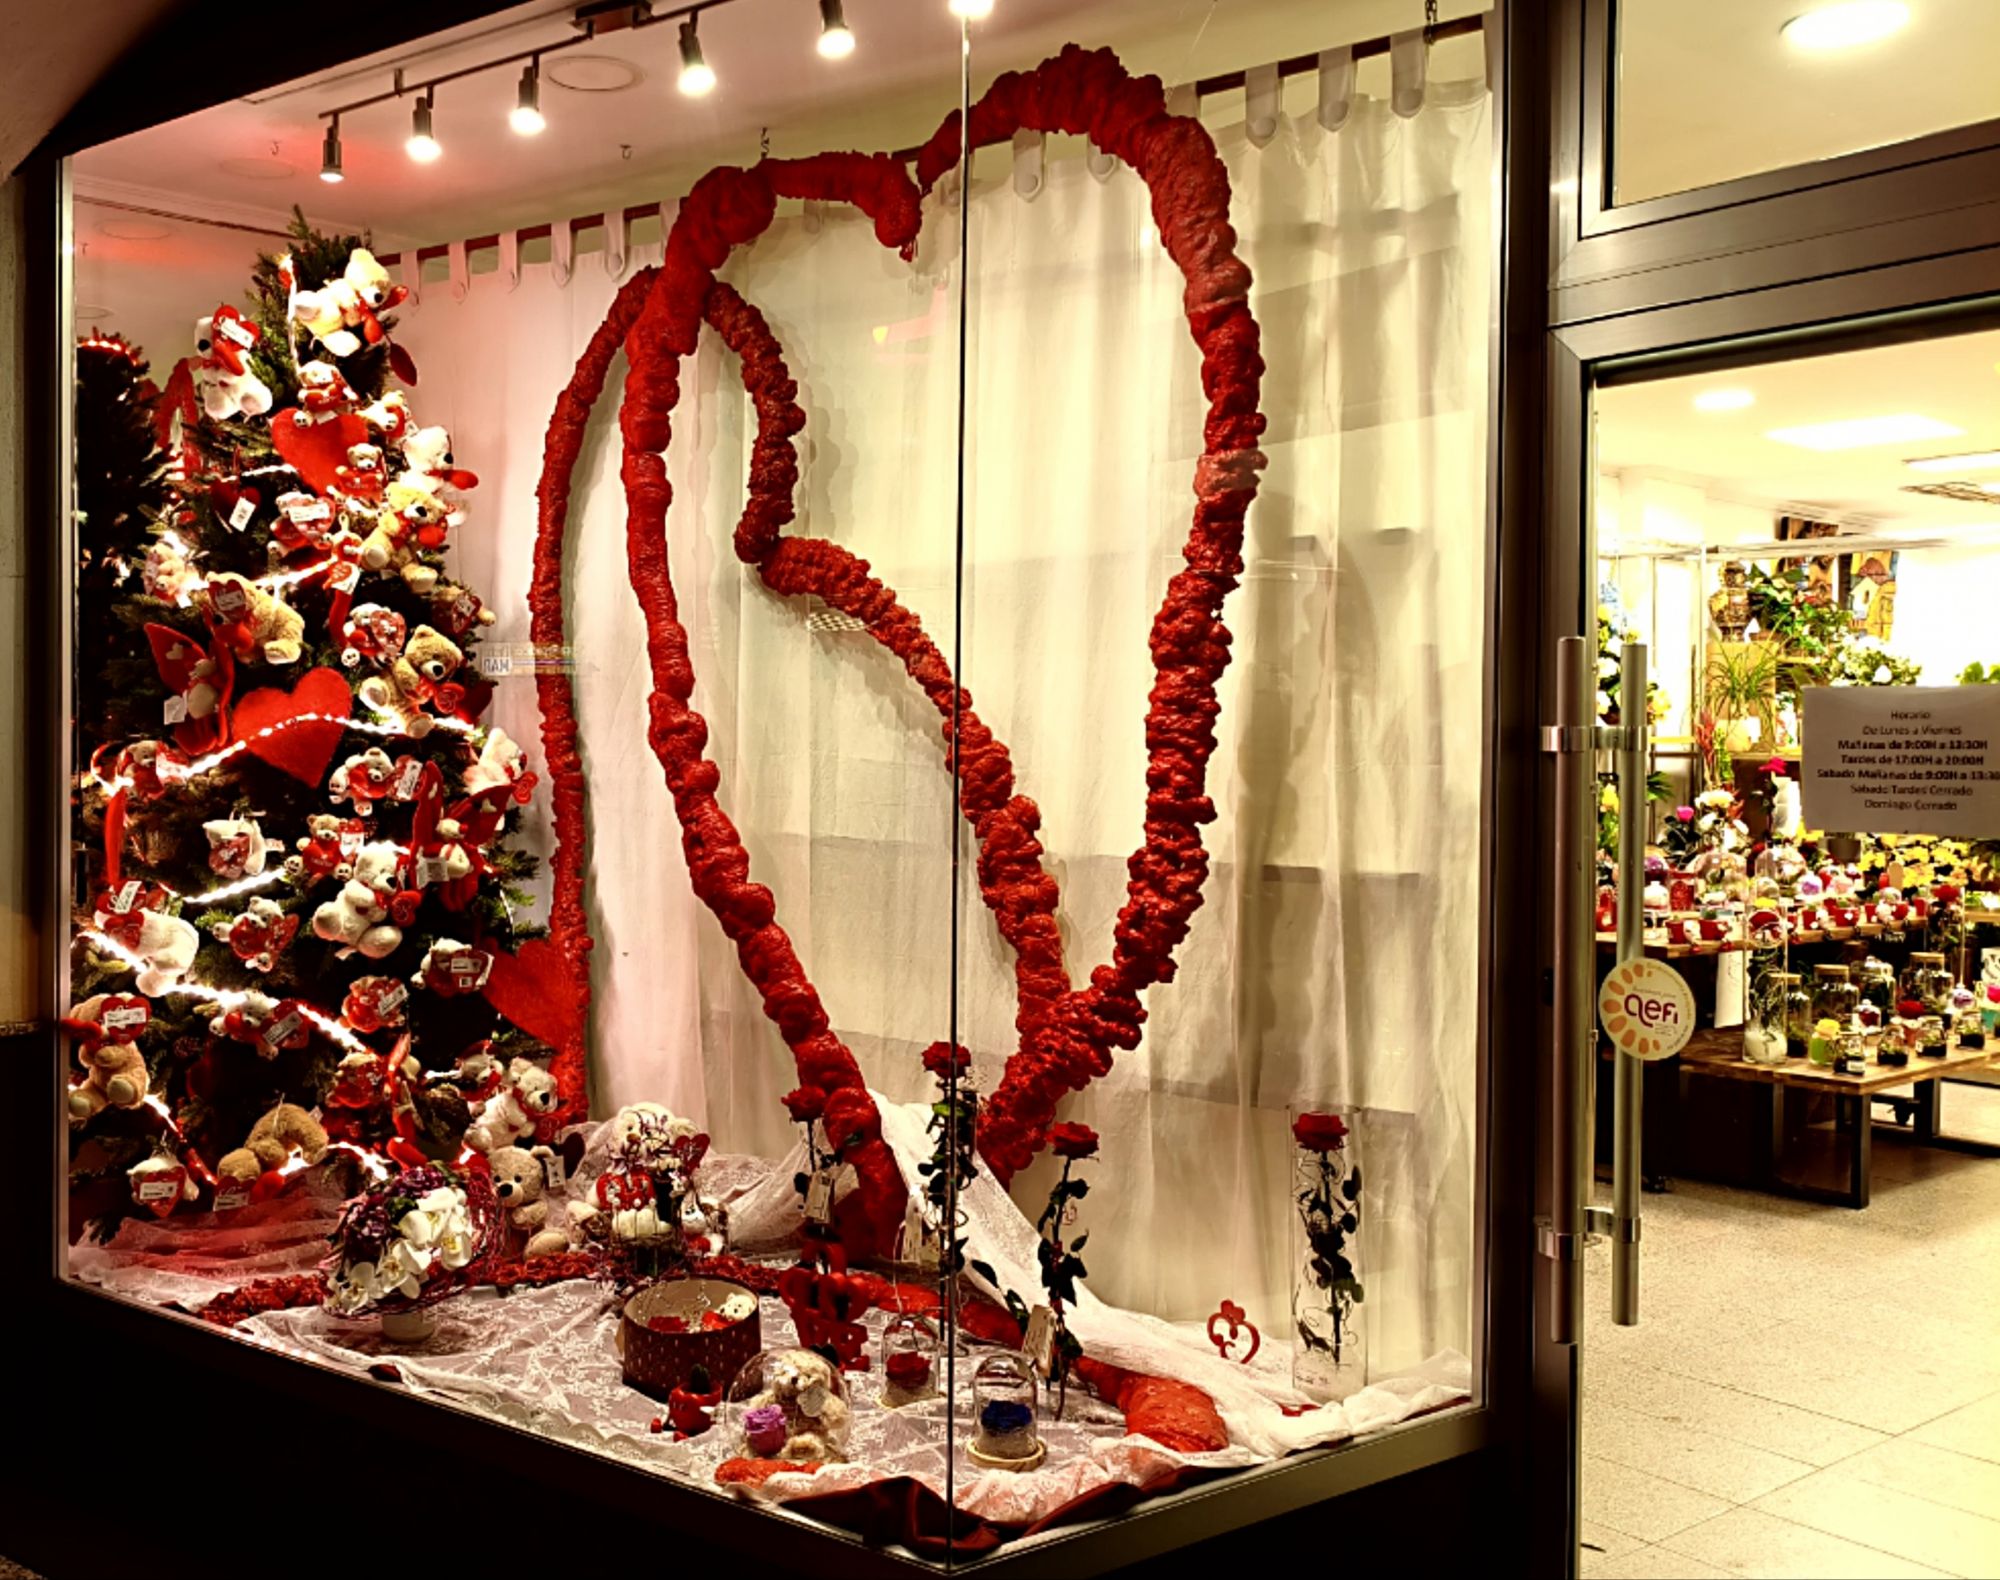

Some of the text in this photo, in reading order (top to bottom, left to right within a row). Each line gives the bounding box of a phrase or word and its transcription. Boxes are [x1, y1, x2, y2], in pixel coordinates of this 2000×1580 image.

[1891, 710, 1931, 720] Horario
[1880, 726, 1910, 735] Lunes
[1889, 740, 1902, 750] de
[1841, 755, 1876, 764] Tardes
[1879, 755, 1892, 764] de
[1909, 770, 1923, 780] de
[1892, 785, 1927, 795] Tardes
[1929, 785, 1973, 796] Cerrado
[1864, 799, 1957, 811] Domingo Cerrado
